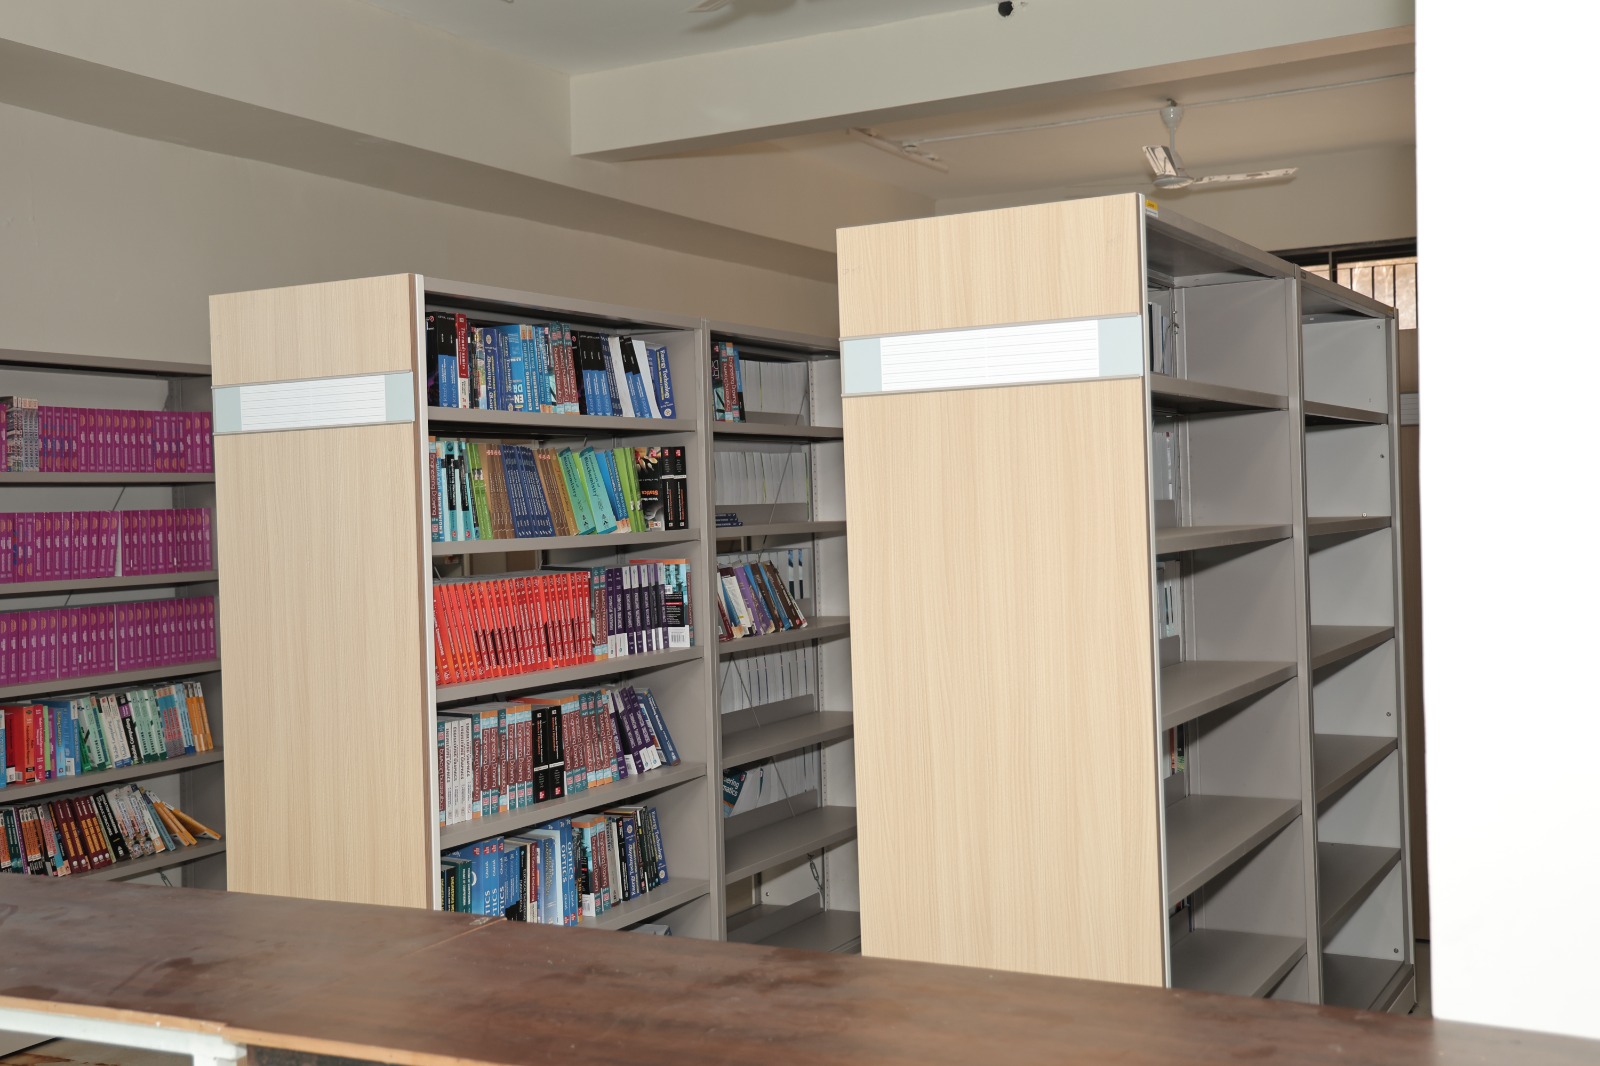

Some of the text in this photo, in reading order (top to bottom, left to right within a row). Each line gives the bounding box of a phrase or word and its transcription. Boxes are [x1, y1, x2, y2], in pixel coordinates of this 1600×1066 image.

[525, 372, 533, 411] ENGINEERING
[563, 456, 577, 498] Biochemistry
[125, 718, 135, 745] Computing
[517, 722, 525, 782] Engineering Drawing
[525, 721, 533, 780] Engineering Drawing
[490, 728, 499, 789] Engineering Drawing
[508, 759, 516, 784] Drawing
[599, 832, 609, 887] Engineering Drawing
